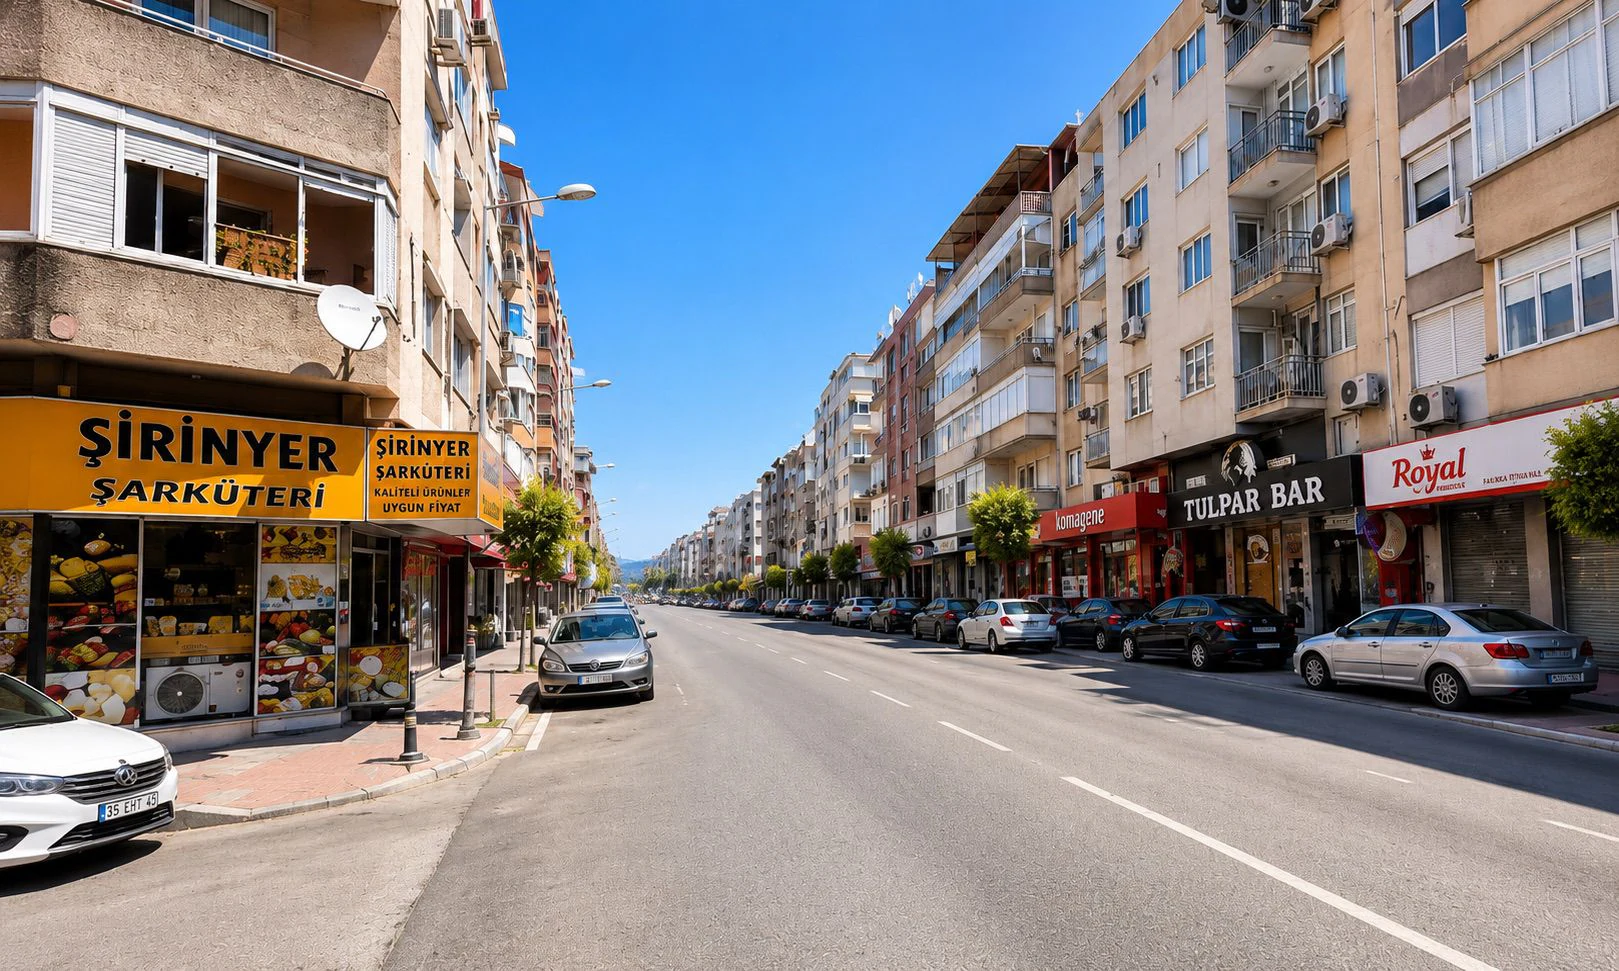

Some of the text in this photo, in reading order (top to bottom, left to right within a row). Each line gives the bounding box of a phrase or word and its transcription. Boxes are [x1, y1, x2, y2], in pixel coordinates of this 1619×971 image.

[78, 409, 339, 473] ŞİRİNYER
[376, 434, 470, 459] ŞİRİNYER
[1392, 447, 1466, 494] Royal
[90, 478, 325, 508] ŞARKÜTERİ
[374, 486, 420, 497] KALİTELİ
[1184, 476, 1325, 522] TULPAR BAR
[383, 500, 461, 513] UYGUN FİYAT
[1055, 508, 1105, 533] komagene
[106, 793, 157, 818] 35 EHT 45
